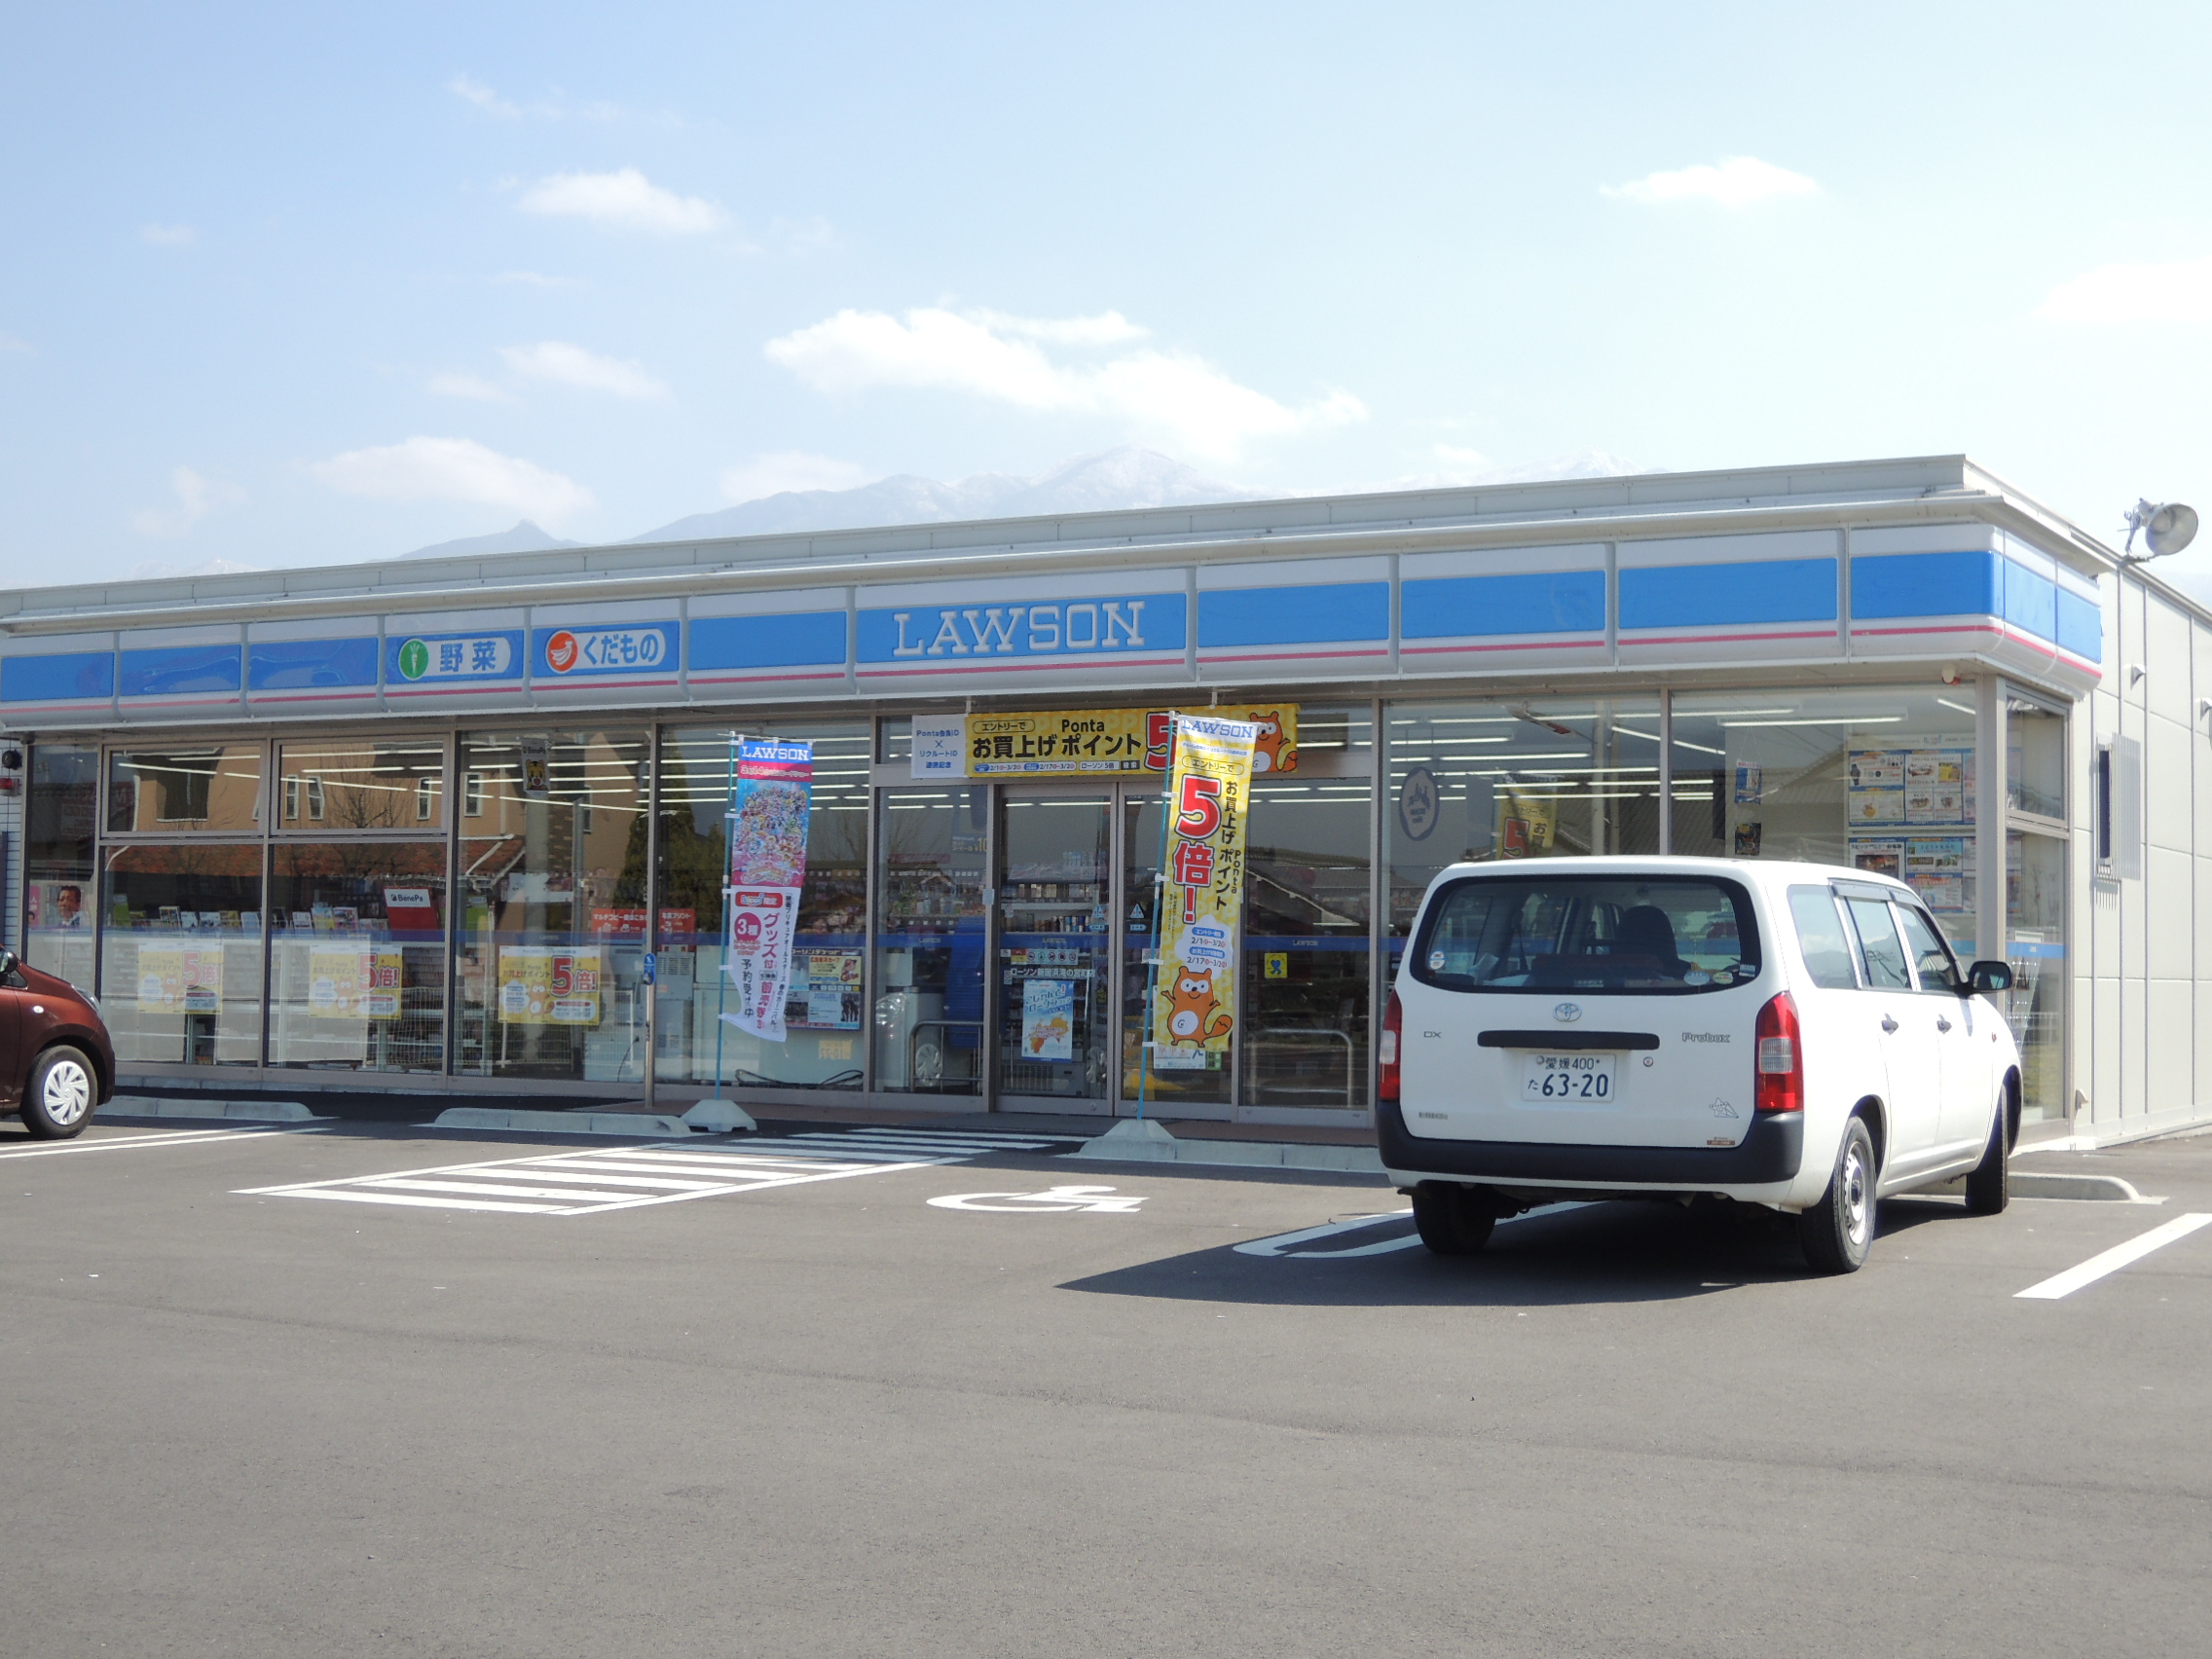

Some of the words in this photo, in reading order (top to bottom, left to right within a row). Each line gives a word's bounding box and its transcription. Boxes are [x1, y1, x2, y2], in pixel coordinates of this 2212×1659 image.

[893, 600, 1145, 656] LAWSON
[440, 641, 497, 672] 野菜
[584, 634, 659, 665] くだもの
[981, 721, 1026, 731] エントリーで
[1061, 719, 1105, 733] Ponta
[1182, 719, 1253, 738] LAWSON
[742, 746, 809, 761] LAWSON
[1191, 757, 1235, 772] エントリーで
[1681, 1032, 1731, 1043] Probox
[1545, 1056, 1569, 1070] 愛媛
[1571, 1057, 1595, 1070] 400
[1528, 1079, 1538, 1090] た
[1542, 1073, 1608, 1097] 63-20
